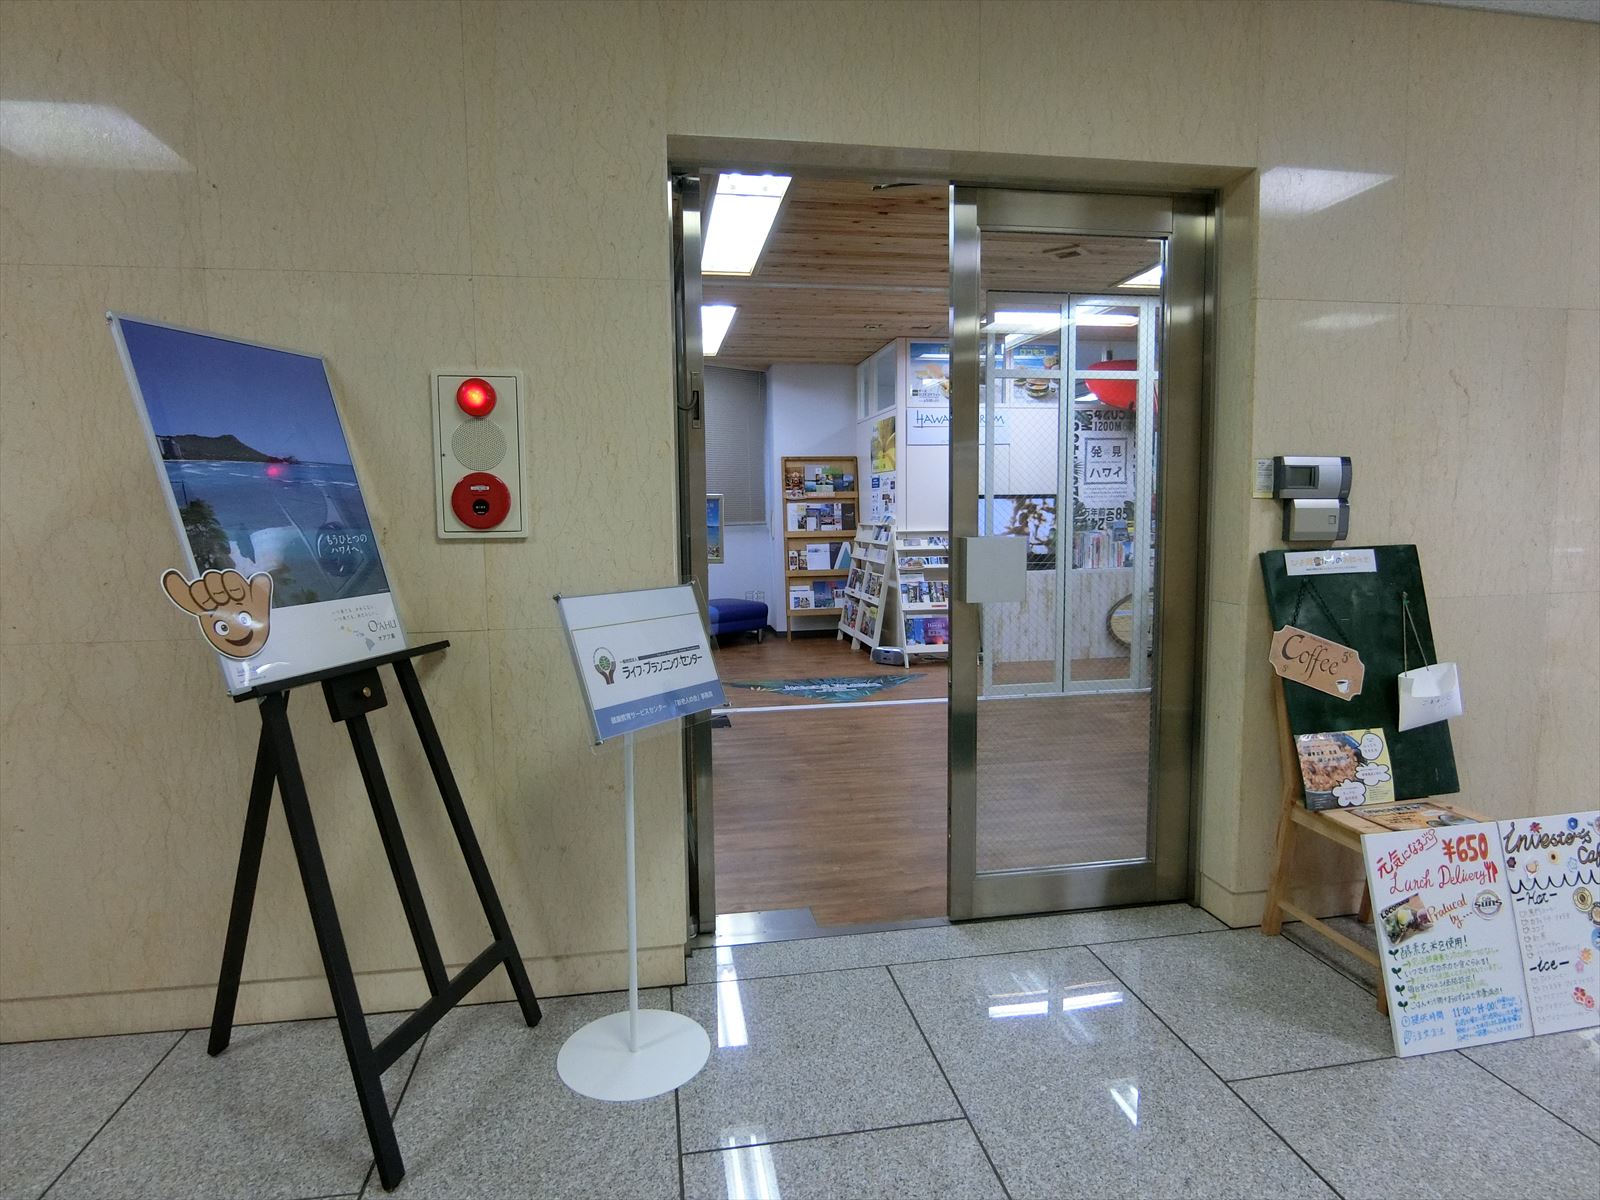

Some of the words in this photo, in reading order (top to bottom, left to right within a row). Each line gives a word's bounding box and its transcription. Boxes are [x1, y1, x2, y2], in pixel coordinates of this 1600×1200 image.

[1090, 466, 1122, 479] ハワイ
[326, 534, 368, 546] もうひとつの
[1282, 634, 1339, 682] Coffee
[1376, 838, 1425, 879] 元気になる
[1442, 832, 1489, 864] ¥650
[1389, 869, 1434, 895] Lunch
[1437, 864, 1487, 889] Delivery
